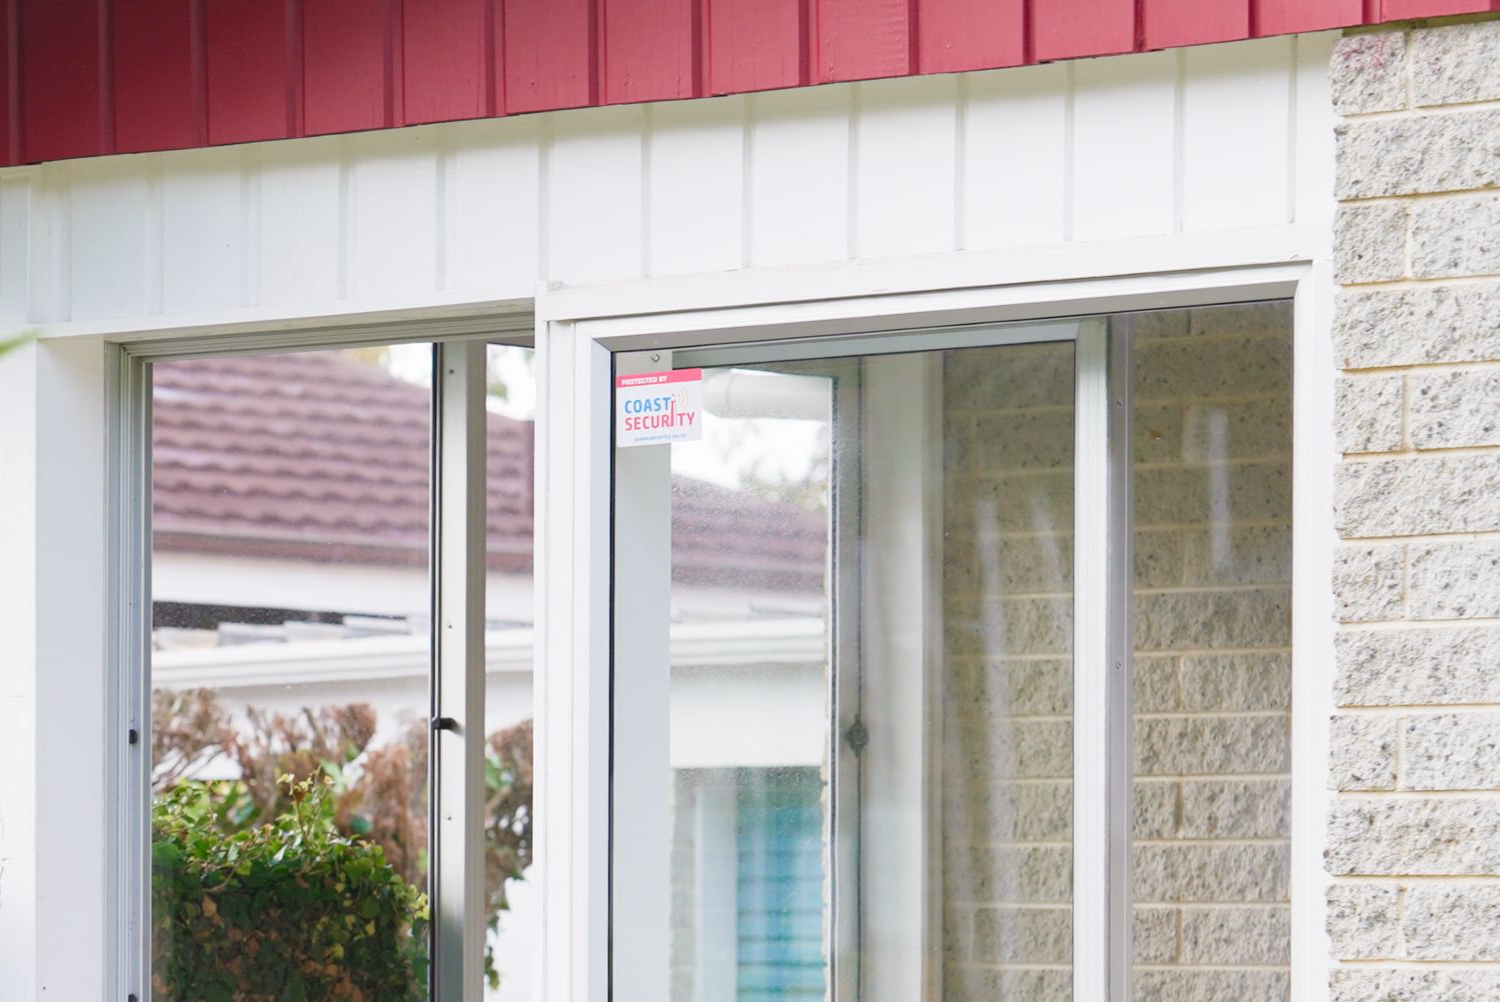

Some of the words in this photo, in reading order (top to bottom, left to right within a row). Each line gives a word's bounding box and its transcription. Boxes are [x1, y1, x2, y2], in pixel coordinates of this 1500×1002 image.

[621, 376, 658, 386] PROTECTED
[625, 397, 671, 413] COAST
[625, 400, 695, 431] SECURITY
